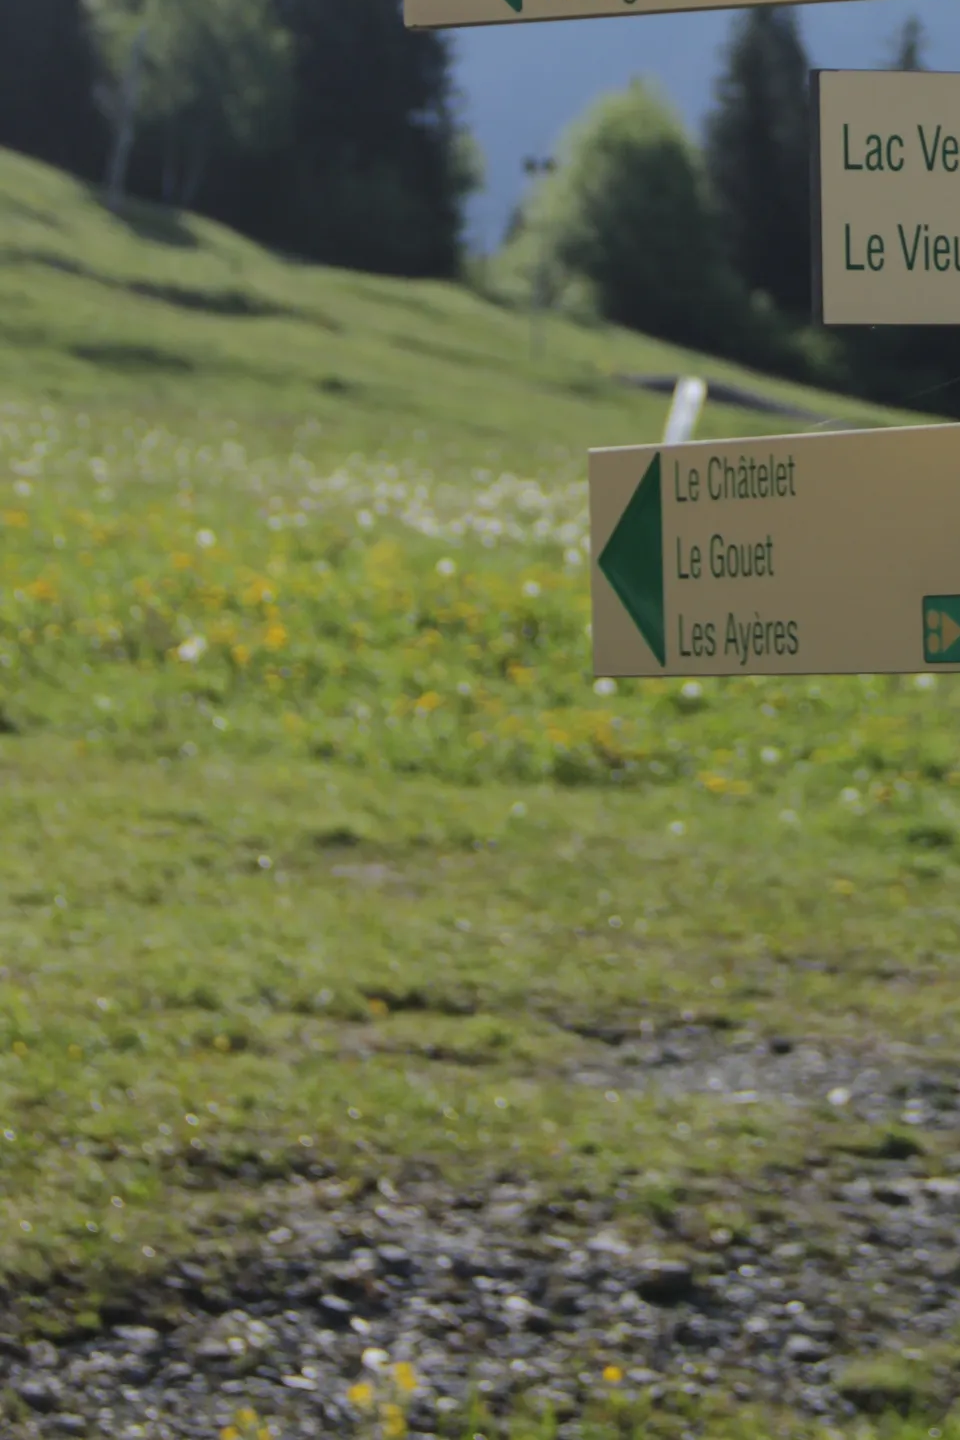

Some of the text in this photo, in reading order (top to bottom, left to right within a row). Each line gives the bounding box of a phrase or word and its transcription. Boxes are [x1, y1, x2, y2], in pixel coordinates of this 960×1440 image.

[844, 124, 904, 171] Lac
[846, 224, 884, 271] Le
[676, 454, 795, 502] Le Châtelet
[678, 534, 773, 579] Le Gouet
[680, 613, 798, 665] Les Ayères
